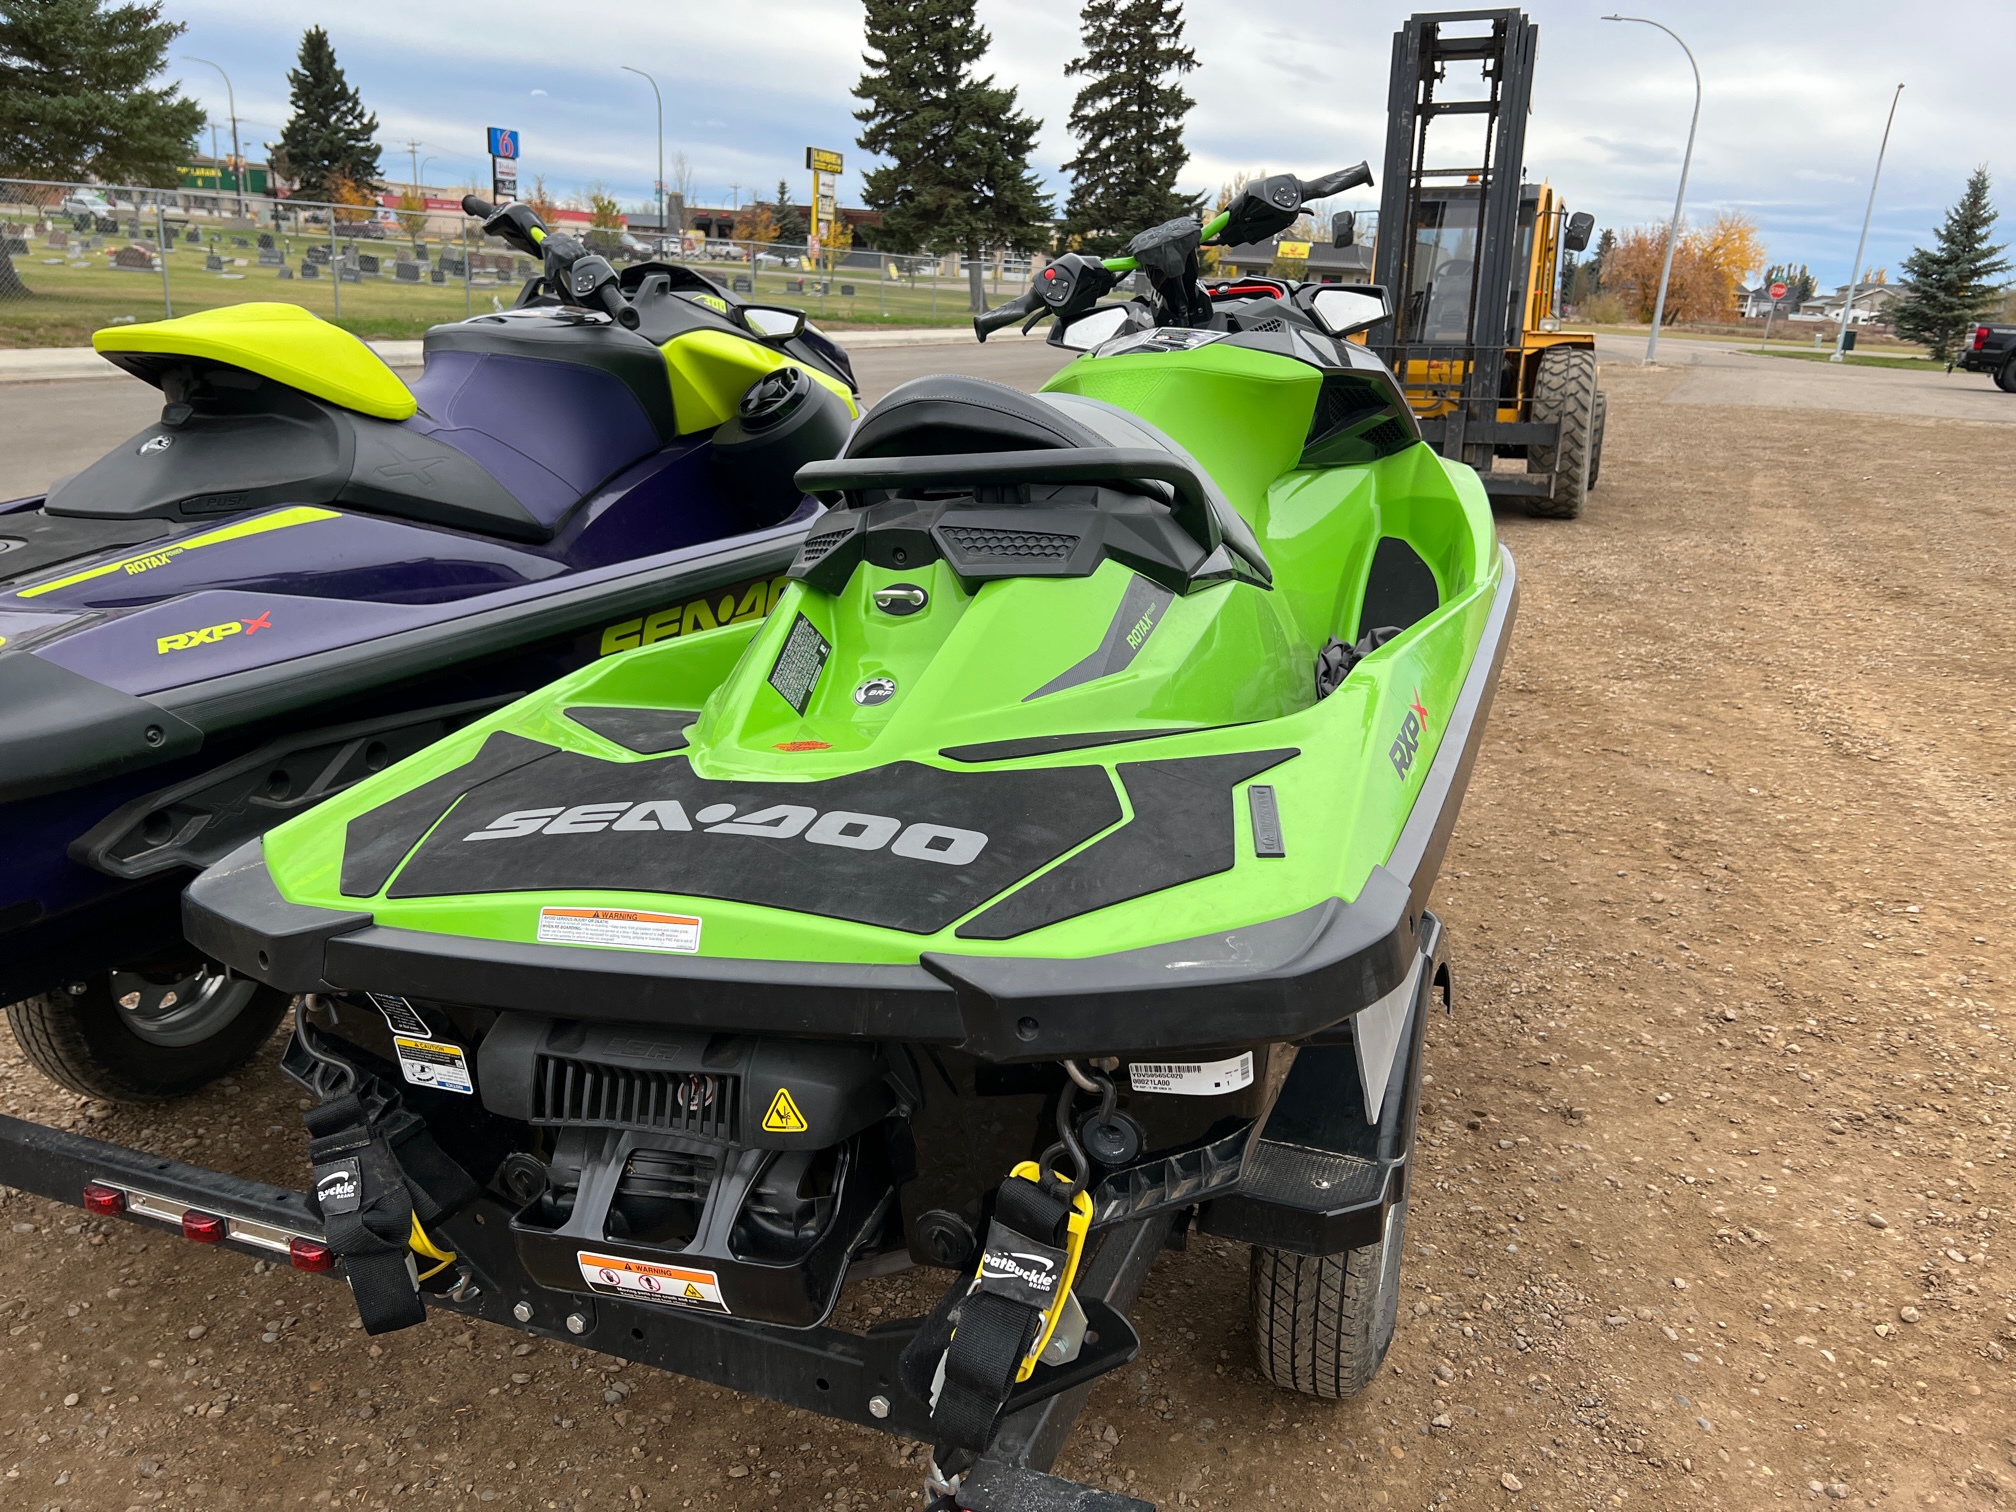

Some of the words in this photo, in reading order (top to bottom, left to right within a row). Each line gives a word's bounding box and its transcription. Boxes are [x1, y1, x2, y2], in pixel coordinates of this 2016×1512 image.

[500, 131, 514, 157] 6
[124, 553, 171, 575] ROTAX
[1126, 612, 1154, 650] ROTAX
[868, 689, 893, 697] BRP
[601, 911, 639, 921] WARNING
[635, 1265, 673, 1277] WARNING
[1029, 1282, 1050, 1292] BRAND
